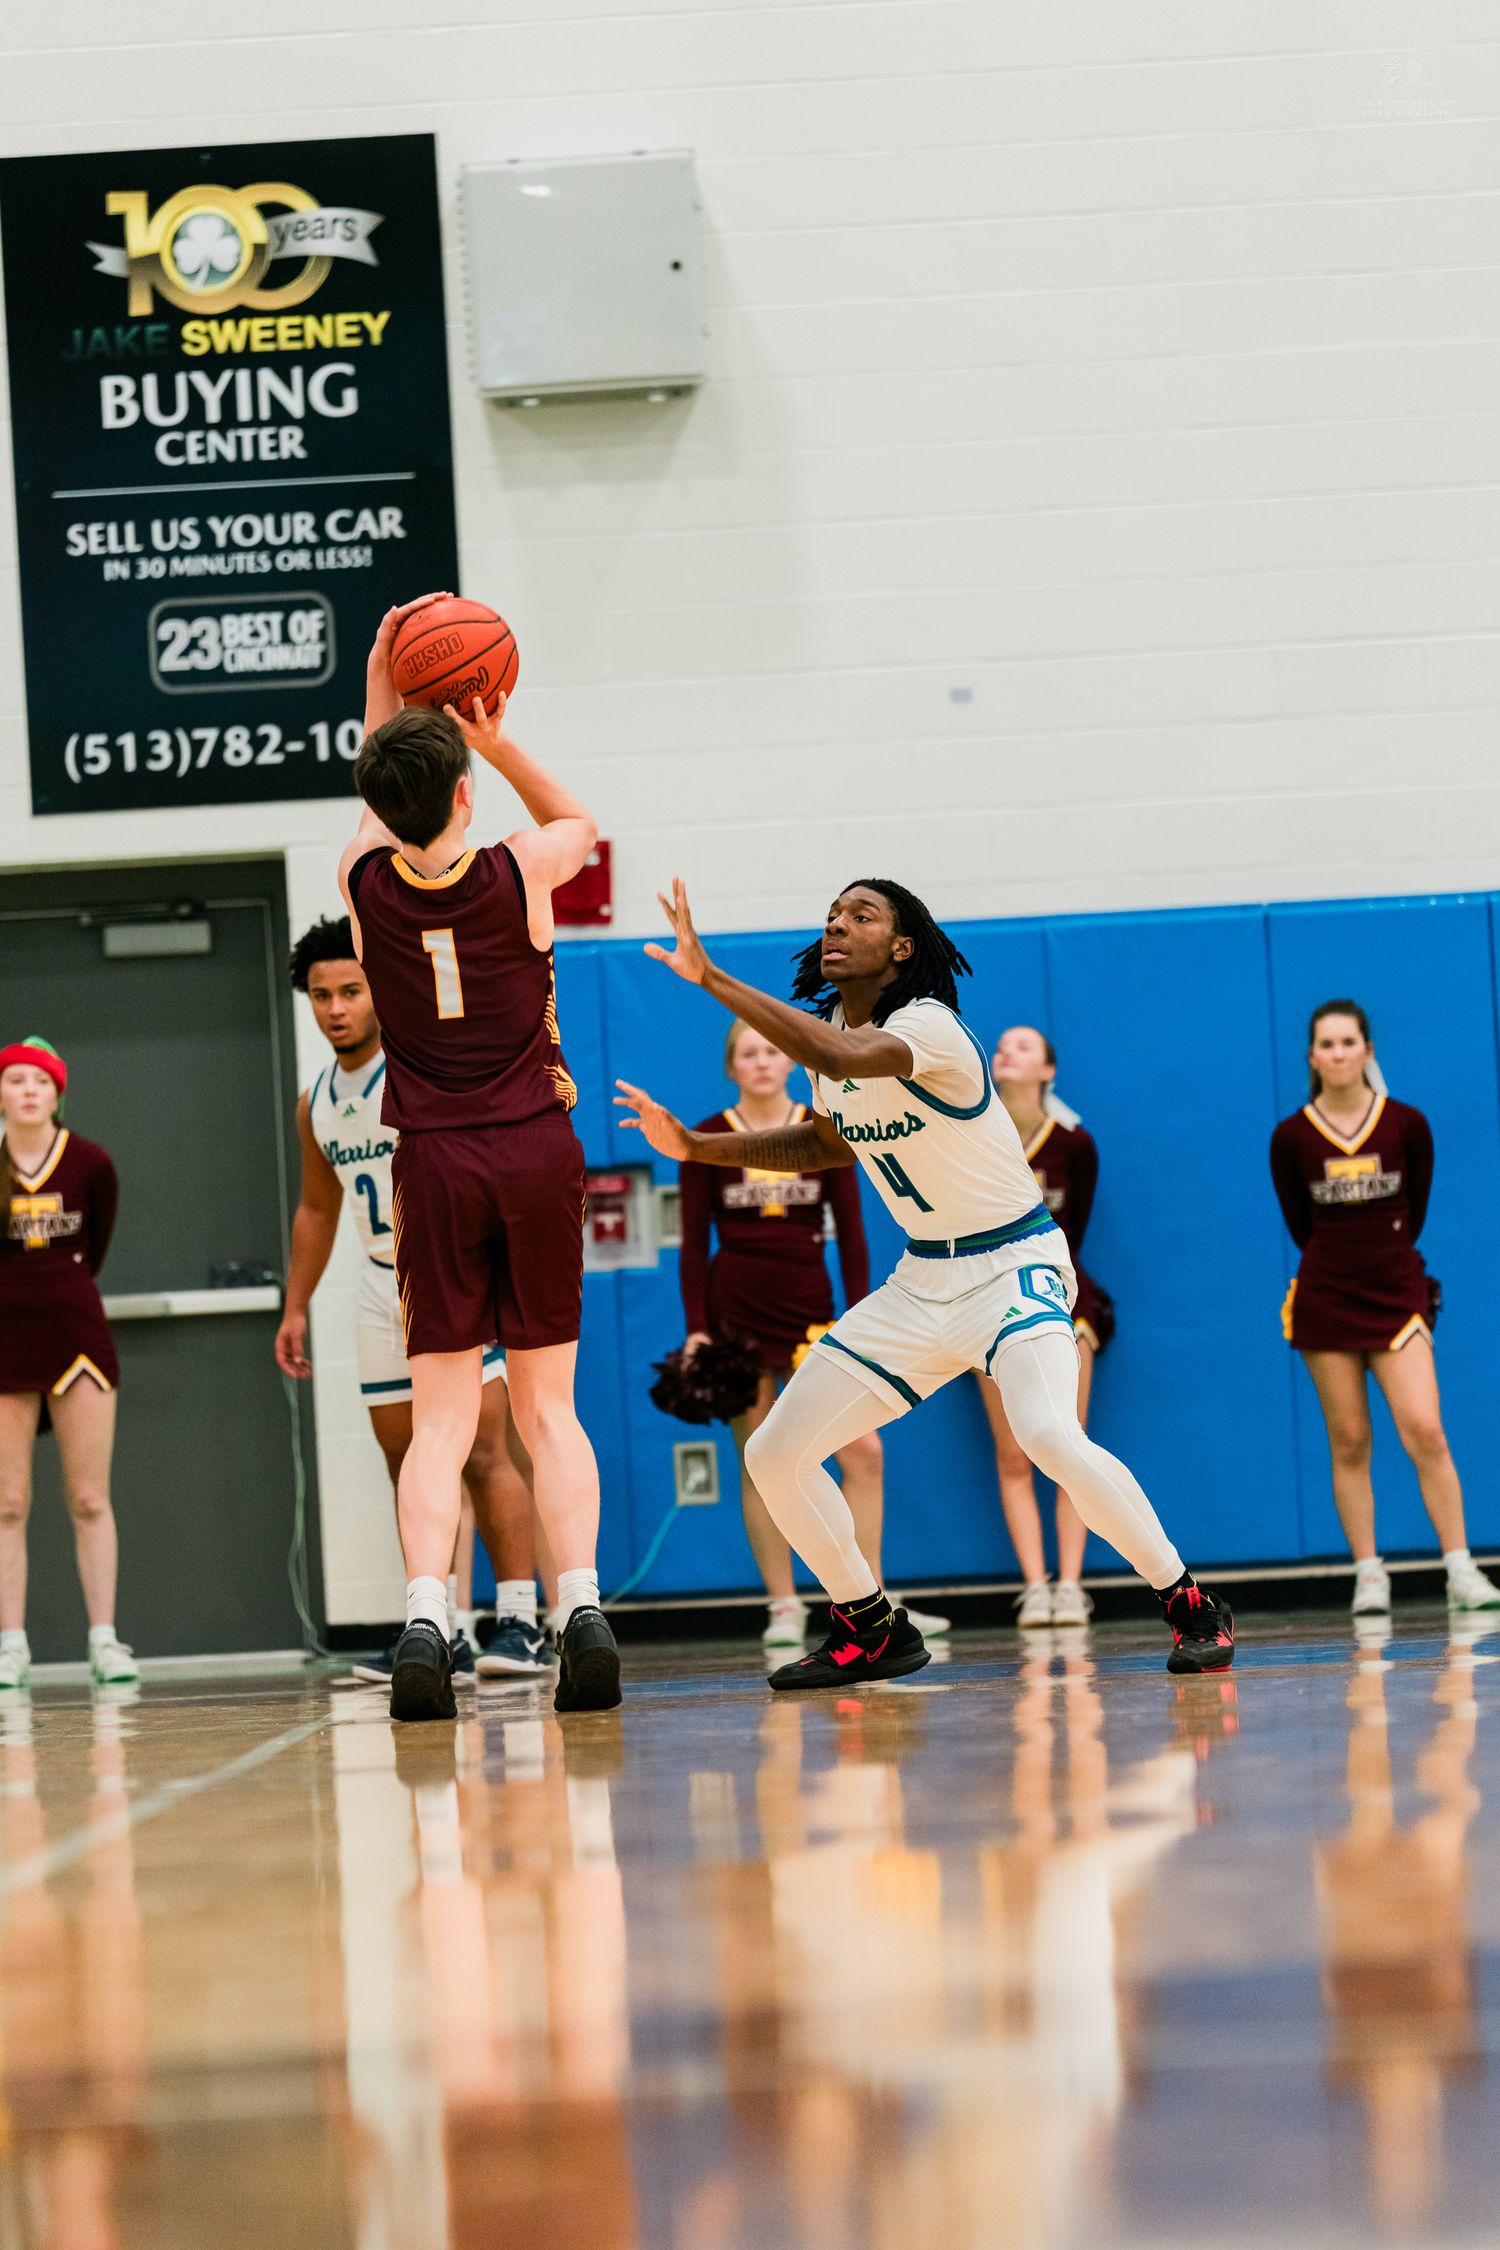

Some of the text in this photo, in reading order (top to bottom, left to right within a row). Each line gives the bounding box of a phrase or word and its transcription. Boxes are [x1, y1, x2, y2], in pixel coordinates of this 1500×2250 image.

[105, 182, 333, 316] 100
[273, 217, 357, 253] years
[63, 311, 391, 361] JAKE SWEENEY
[99, 362, 359, 430] BUYING
[154, 425, 308, 467] CENTER
[66, 507, 406, 557] SELL US YOUR CAR
[103, 545, 373, 582] IN 30 MINUTES OR LESS!
[157, 616, 223, 673] 23
[221, 609, 326, 649] BEST OF
[401, 632, 464, 680] OHSAA
[430, 666, 489, 711] Rawl
[64, 719, 365, 784] (513)782-10
[421, 928, 464, 1020] 1
[323, 1139, 396, 1168] Warrior
[355, 1173, 394, 1236] 2
[869, 1153, 935, 1213] 4
